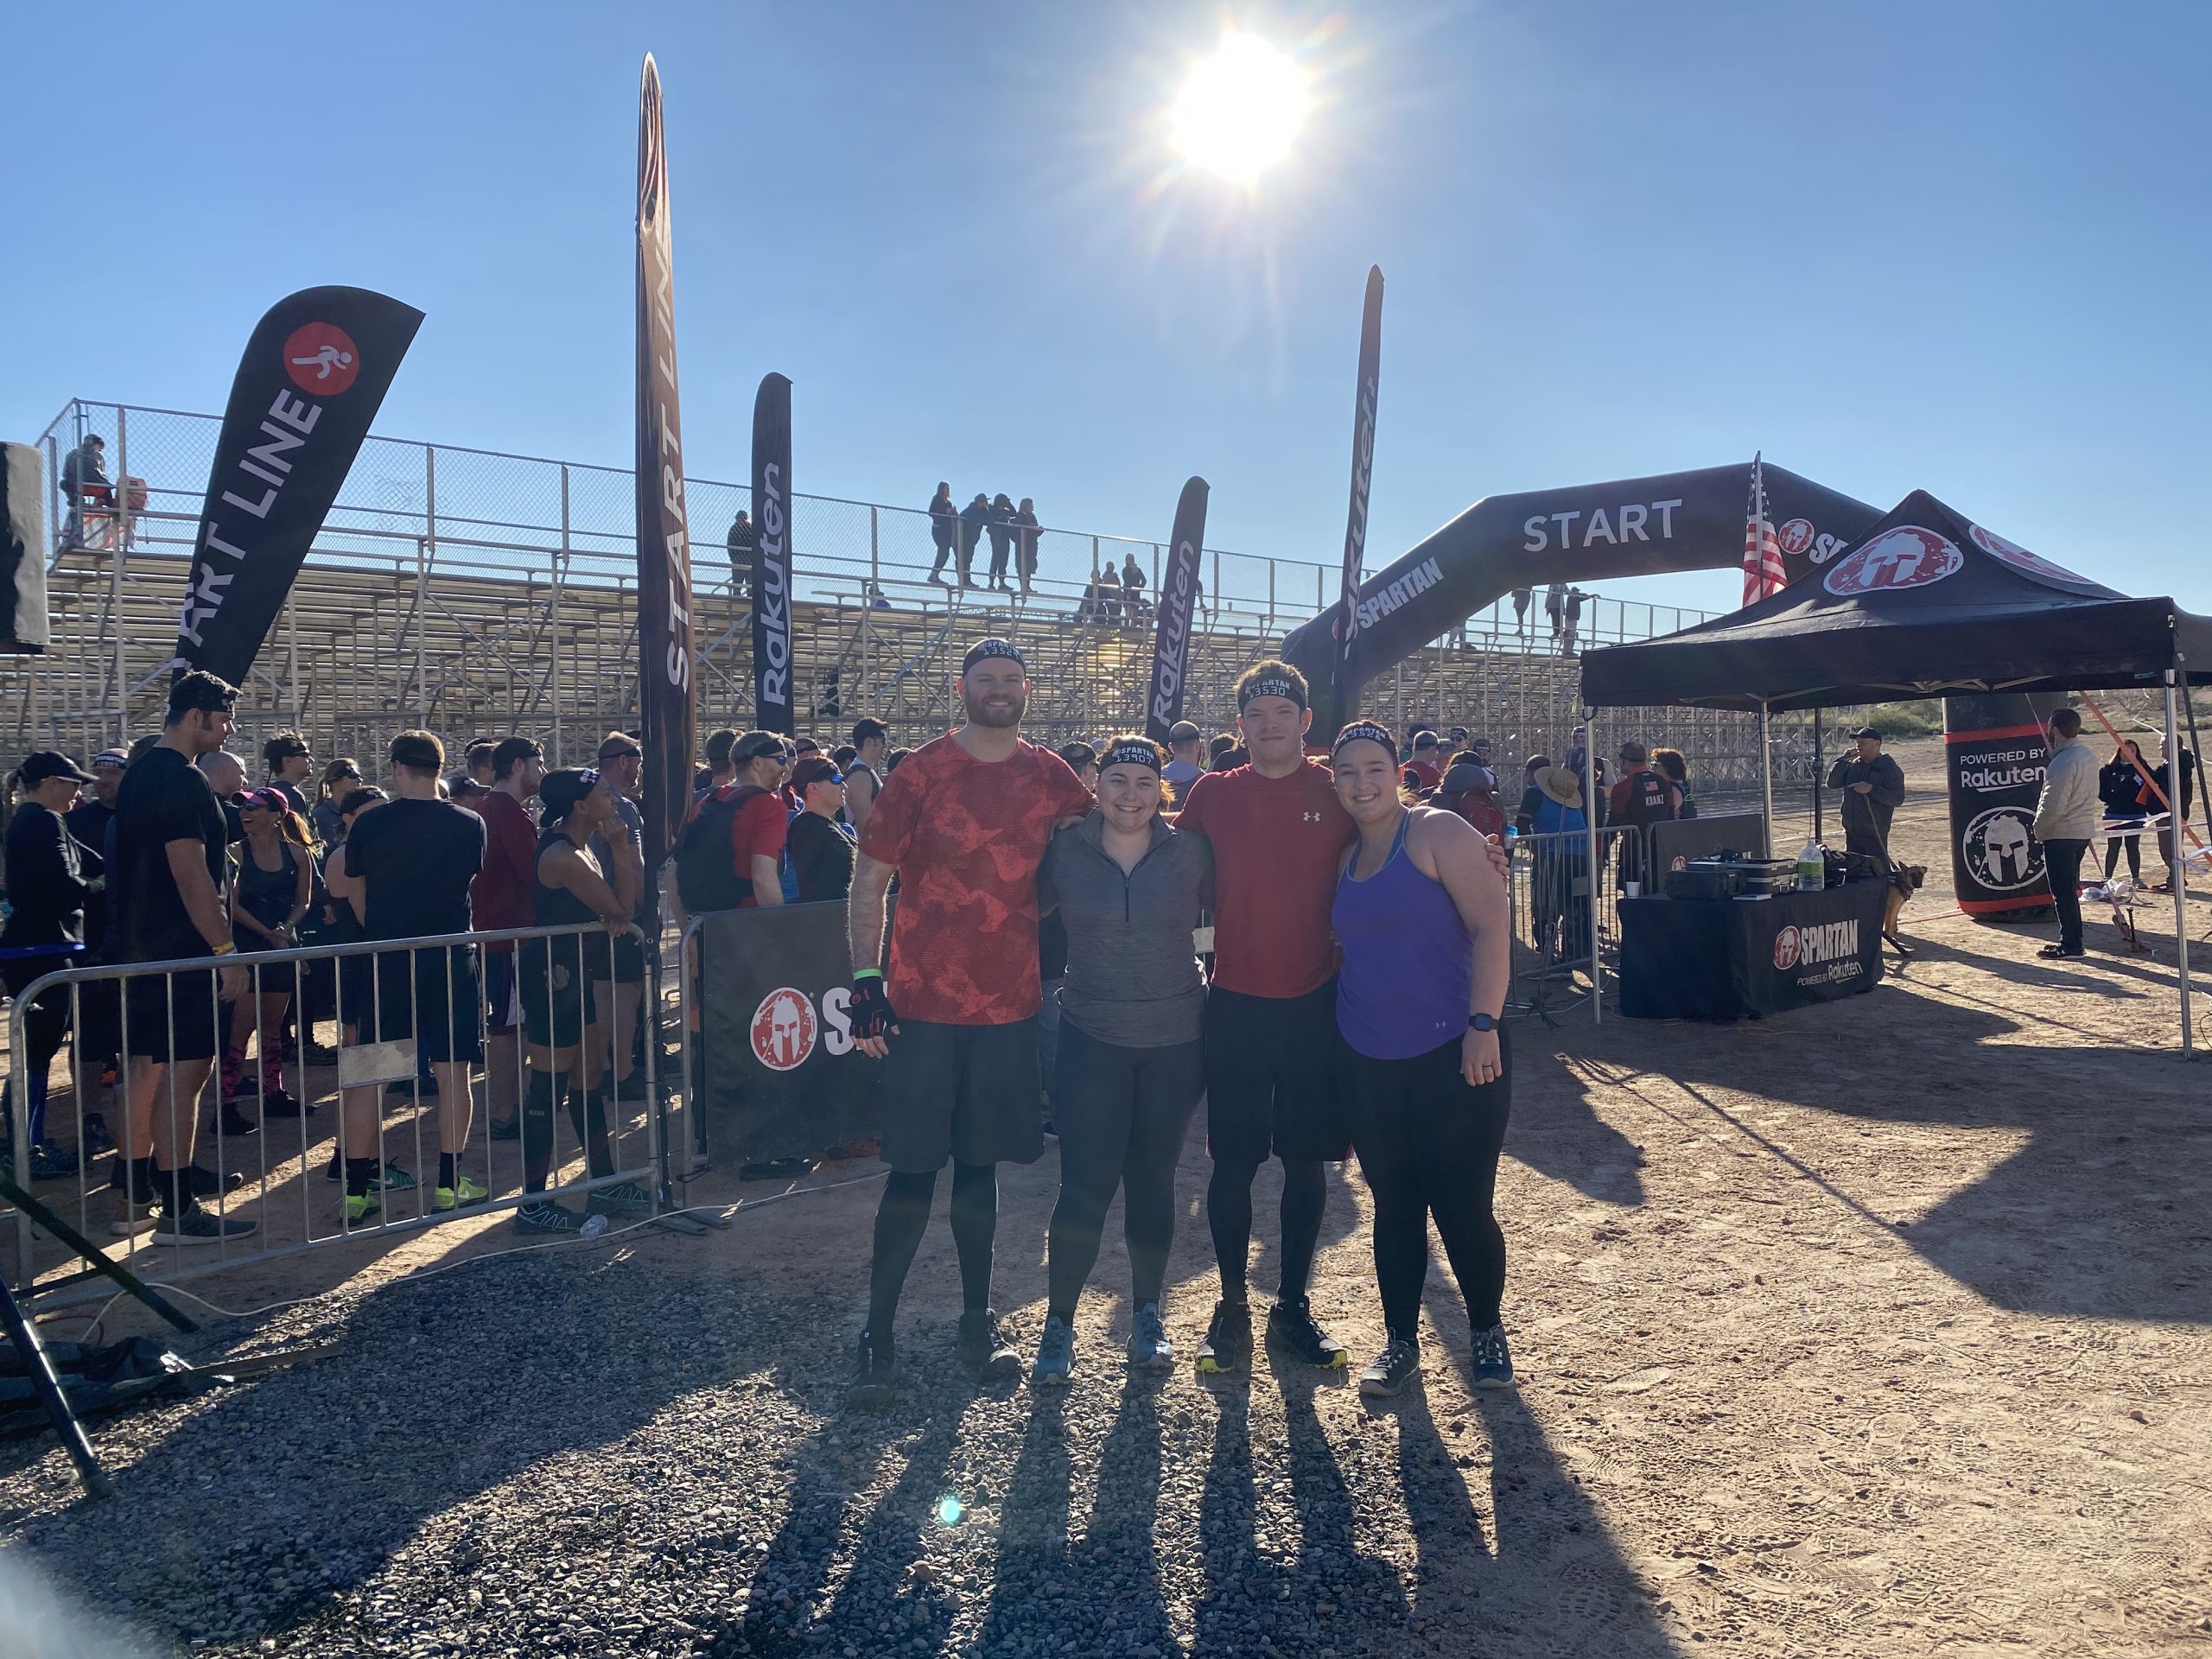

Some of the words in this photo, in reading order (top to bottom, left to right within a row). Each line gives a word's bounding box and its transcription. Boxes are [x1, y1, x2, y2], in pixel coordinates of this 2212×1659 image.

[173, 521, 246, 671] ART
[221, 388, 322, 518] LINE
[661, 403, 690, 694] START
[1523, 499, 1682, 552] START
[760, 461, 787, 706] Rakuten
[1357, 556, 1444, 628] SPARTAN
[1153, 540, 1193, 728] Rakuten
[1121, 747, 1154, 760] SPARTAN
[1961, 750, 2026, 766] POWERED
[2030, 747, 2046, 760] BY
[1961, 766, 2047, 789] Rakuten
[1801, 919, 1859, 965] SPARTAN
[1797, 975, 1822, 986] POWERED
[1827, 961, 1863, 982] Rakuten
